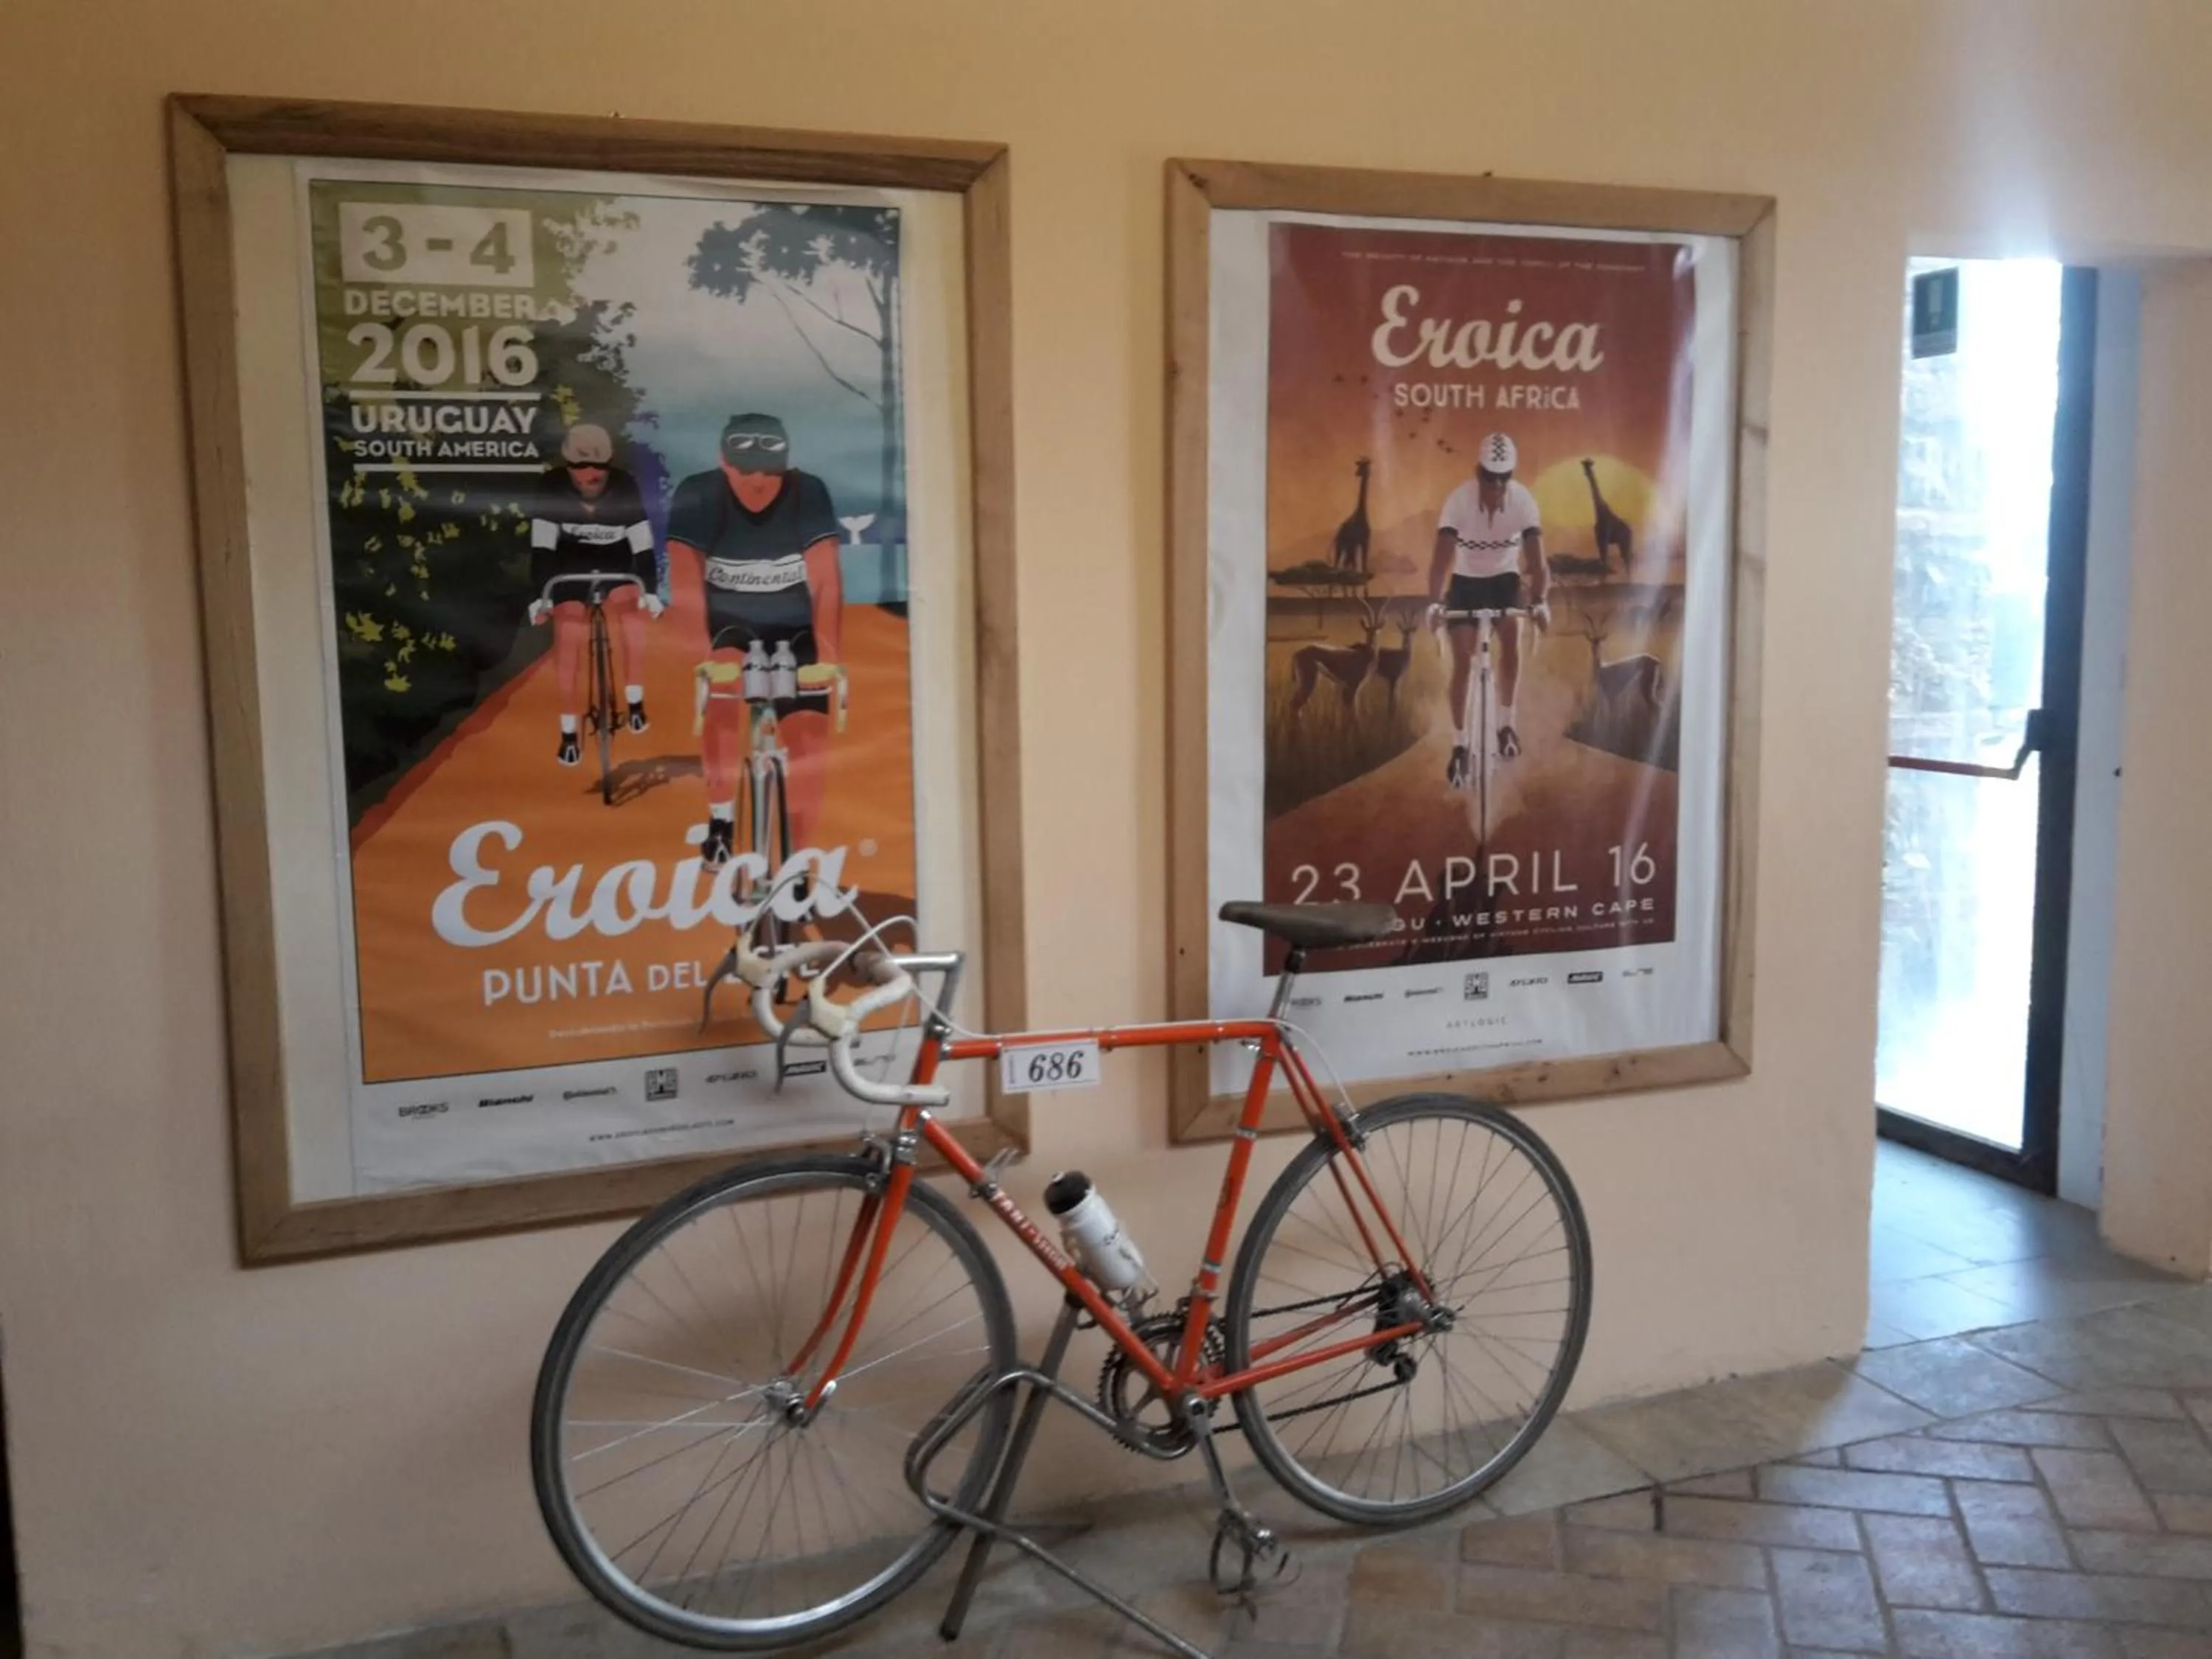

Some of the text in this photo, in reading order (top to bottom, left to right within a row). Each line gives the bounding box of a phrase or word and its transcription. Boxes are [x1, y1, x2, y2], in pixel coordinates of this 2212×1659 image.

[362, 215, 408, 271] 3
[470, 220, 516, 274] 4
[344, 289, 539, 319] DECEMBER
[1371, 284, 1605, 372] Eroica
[347, 322, 539, 387] 2016
[1394, 383, 1484, 409] SOUTH
[350, 405, 538, 436] URUGUAY
[354, 439, 540, 459] SOUTH AMERICA
[431, 820, 859, 948] Eroica
[1291, 841, 1657, 906] 23 APRIL 16
[1452, 897, 1655, 928] WESTERN CAPE
[483, 960, 633, 1006] PUNTA
[648, 961, 708, 992] DEL
[1028, 1049, 1085, 1082] 686
